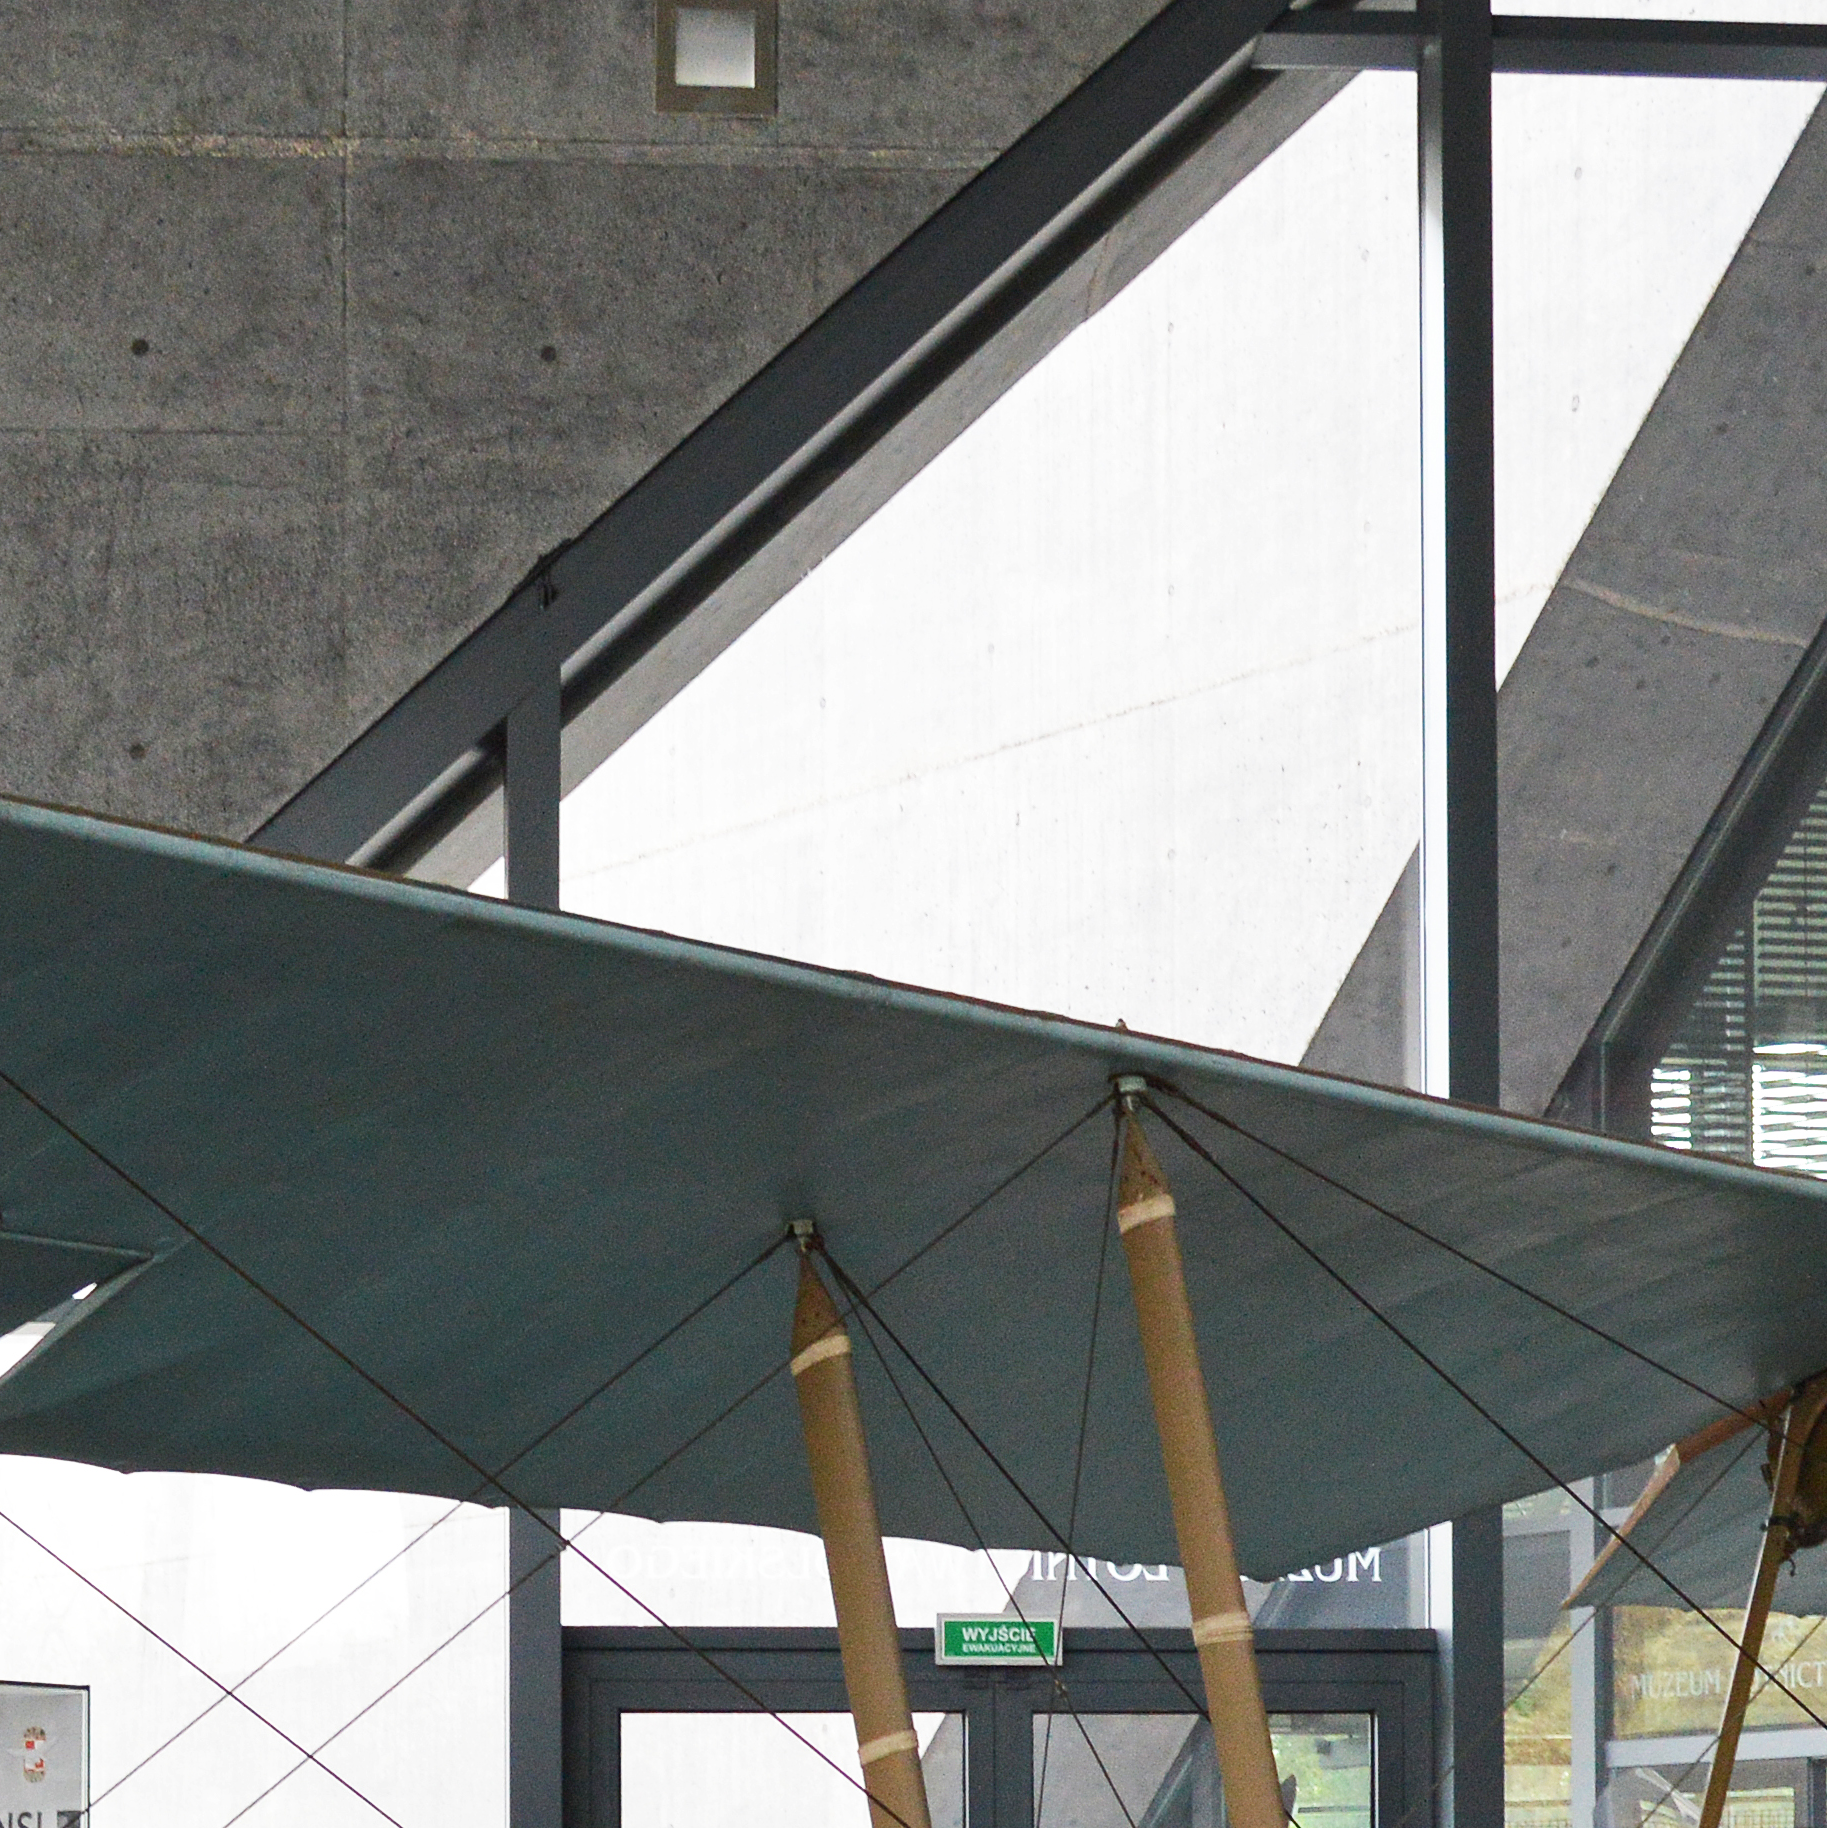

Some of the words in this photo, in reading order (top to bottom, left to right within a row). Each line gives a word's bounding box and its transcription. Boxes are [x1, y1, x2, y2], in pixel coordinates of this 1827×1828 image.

[962, 1624, 1036, 1642] WYJŚCIE
[962, 1643, 1036, 1653] EWAKUACYJNE
[1631, 1668, 1721, 1700] MUZEUM
